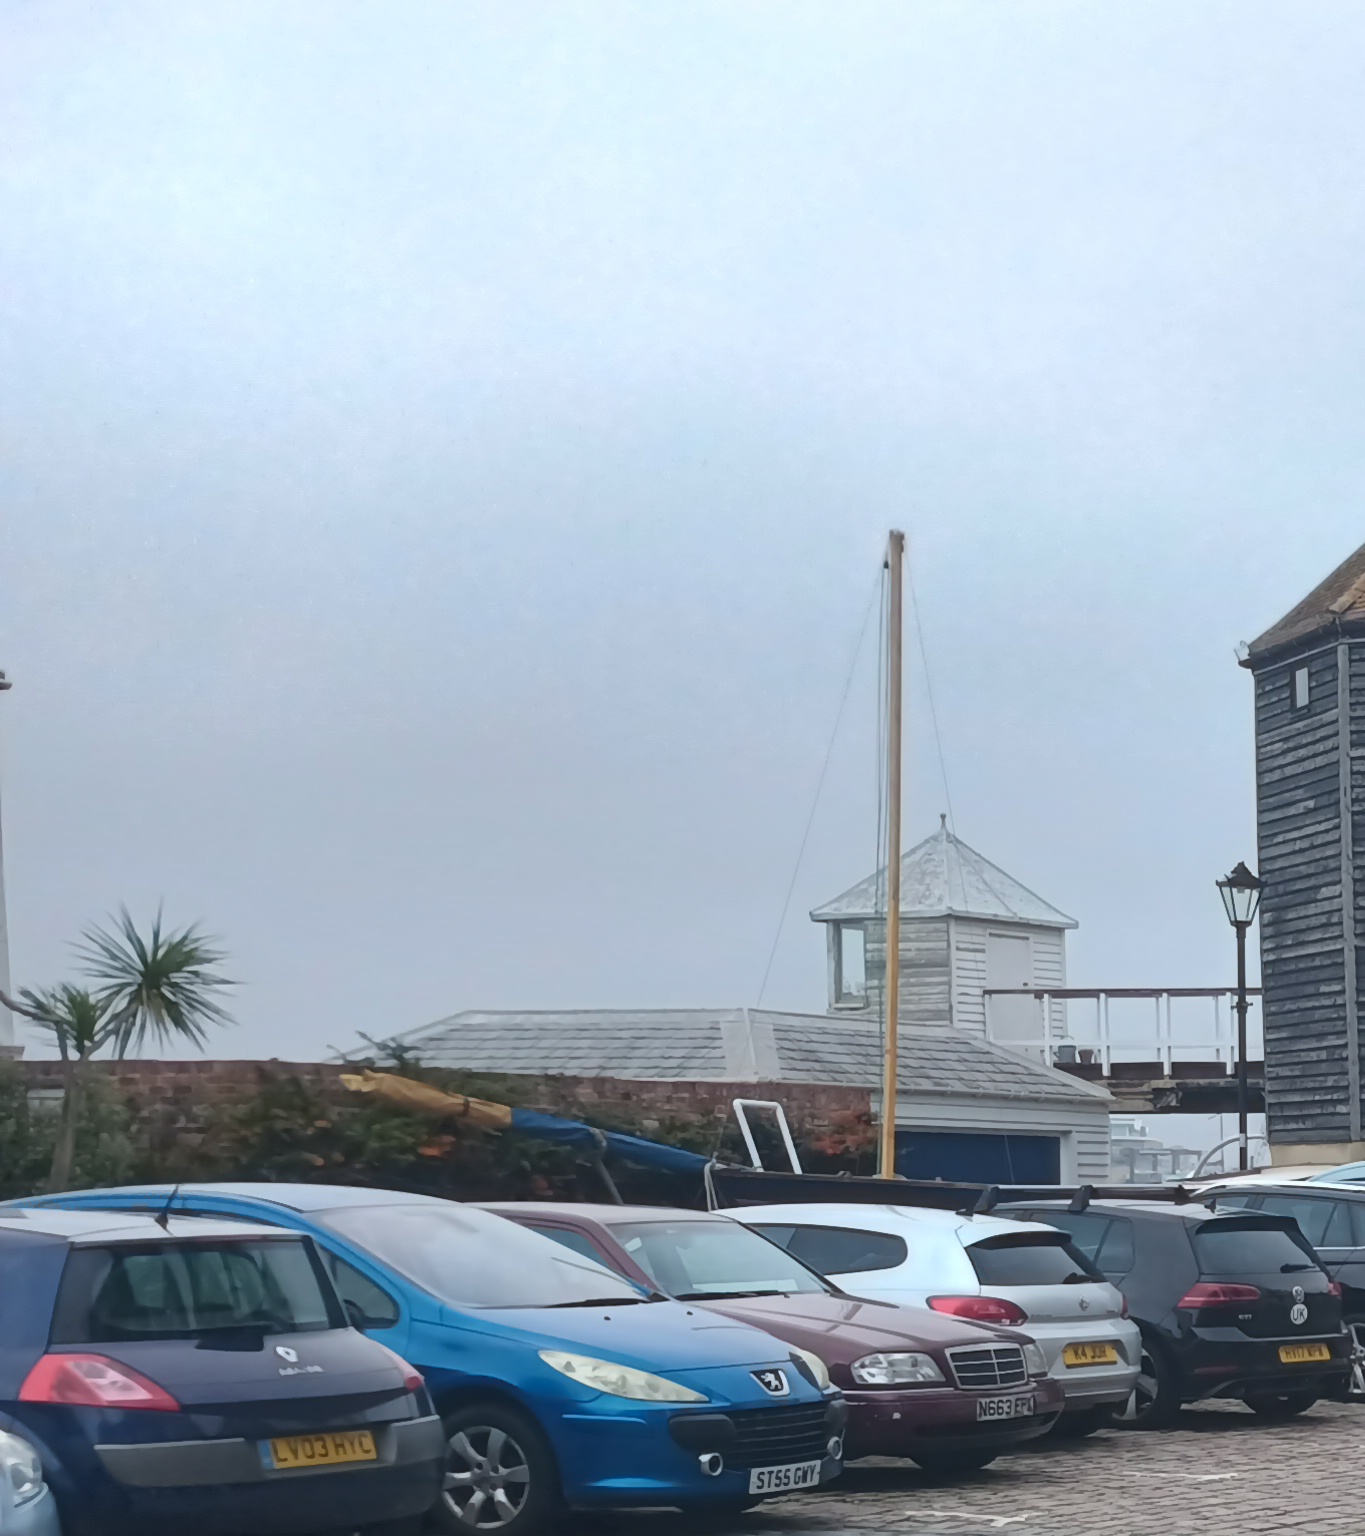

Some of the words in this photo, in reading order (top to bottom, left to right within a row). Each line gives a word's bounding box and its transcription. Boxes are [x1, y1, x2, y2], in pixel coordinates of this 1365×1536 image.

[1292, 1307, 1305, 1321] UK
[978, 1399, 1012, 1418] N663
[272, 1436, 329, 1462] LV03
[331, 1433, 371, 1456] HYC
[757, 1468, 791, 1490] ST55
